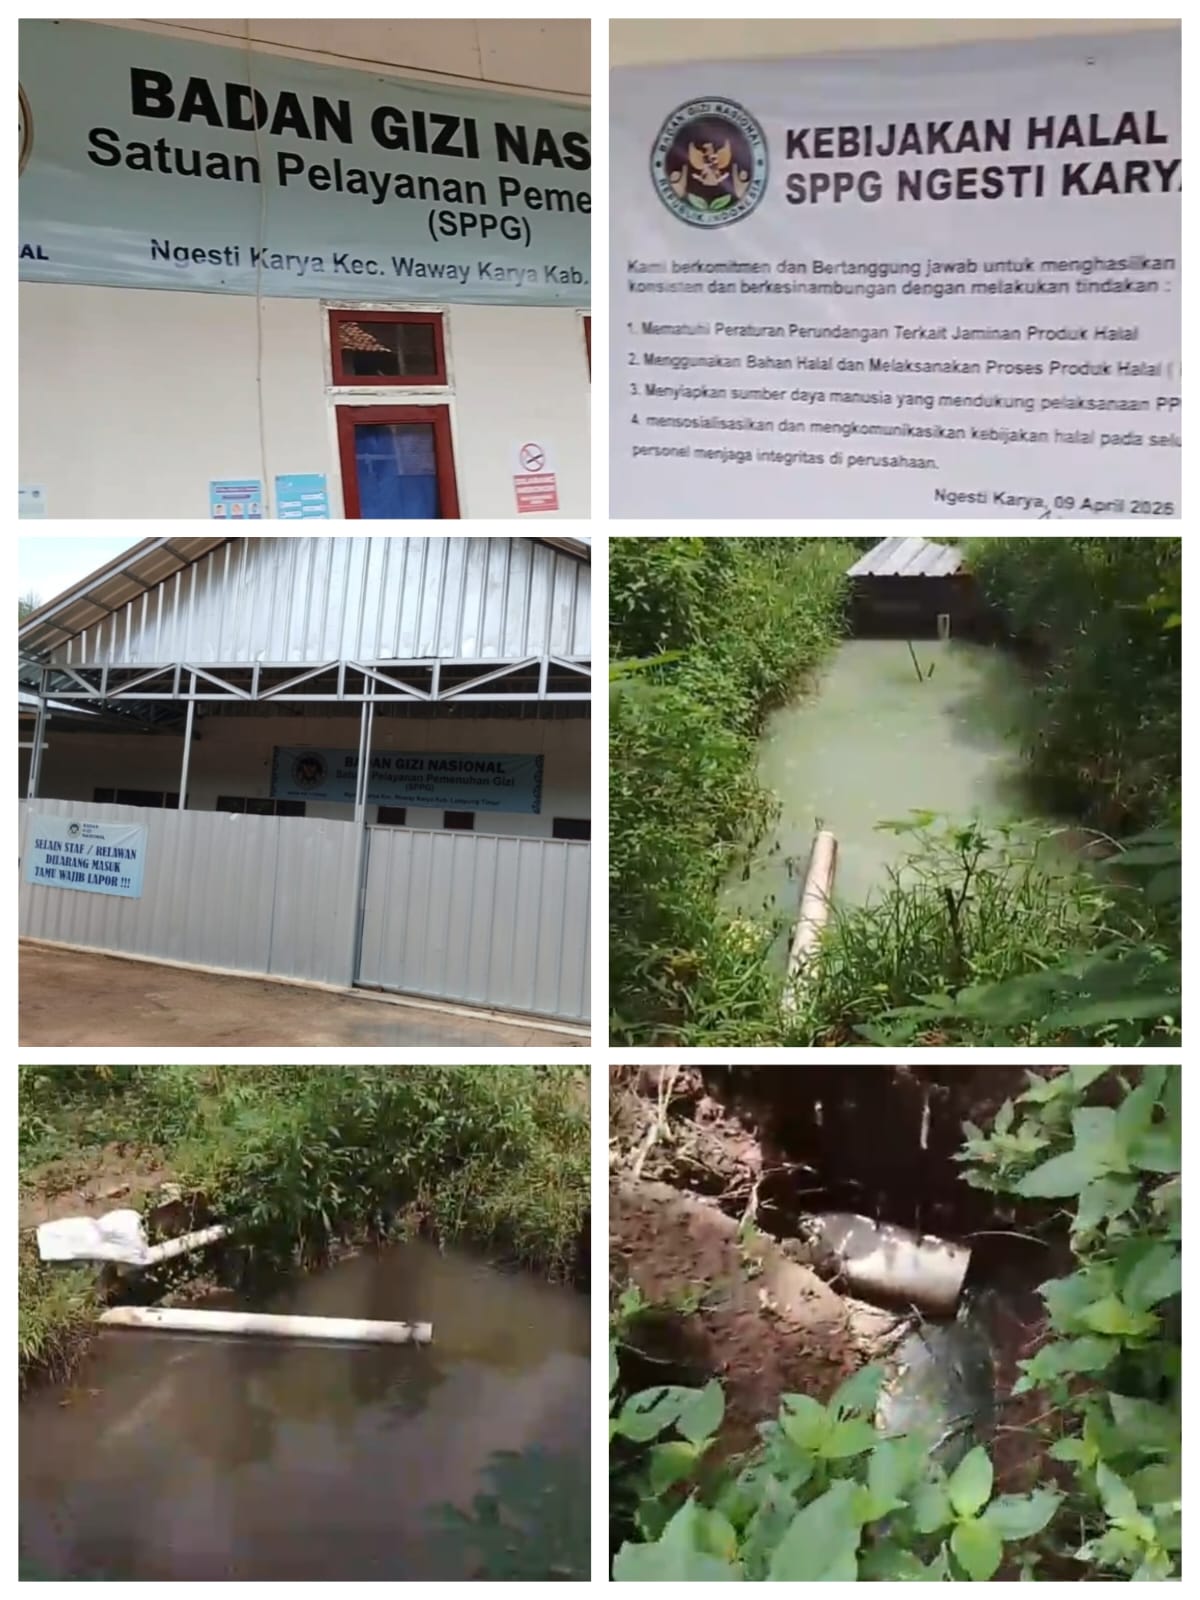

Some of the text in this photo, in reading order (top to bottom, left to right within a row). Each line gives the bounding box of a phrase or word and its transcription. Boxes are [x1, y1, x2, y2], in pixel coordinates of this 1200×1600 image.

[130, 67, 591, 171] BADAN GIZI NAS
[785, 110, 1169, 160] KEBIJAKAN HALAL
[87, 126, 591, 214] Satuan Pelayanan Peme
[785, 157, 1181, 205] SPPG NGESTI KARY
[428, 208, 532, 248] (SPPG)
[150, 238, 590, 287] Ngesti Karya Kec. Waway Karya Kab.
[671, 259, 771, 275] berkomitmen
[776, 259, 807, 275] dan
[811, 259, 921, 278] Bertanggung
[926, 258, 978, 277] jawab
[983, 257, 1035, 273] untuk
[1040, 255, 1176, 275] menghasilkan
[707, 279, 737, 294] dan
[740, 279, 897, 298] berkesinambungan
[901, 280, 966, 298] dengan
[971, 279, 1070, 294] melakukan
[1075, 277, 1159, 293] tindakan
[714, 322, 785, 337] Peraturan
[788, 323, 888, 342] Perundangan
[894, 325, 948, 340] Terkait
[951, 326, 1021, 341] Jaminan
[1027, 325, 1089, 341] Produk
[1093, 326, 1139, 341] Halal
[628, 352, 640, 366] 2.
[644, 352, 741, 370] Menggunakan
[746, 354, 792, 369] Bahan
[796, 355, 833, 371] Halal
[837, 356, 865, 372] dan
[868, 358, 981, 374] Melaksanakan
[986, 360, 1044, 375] Proses
[1049, 360, 1112, 376] Produk
[1116, 361, 1162, 377] Halal
[630, 383, 640, 396] 3.
[644, 383, 727, 400] Menyiapkan
[730, 385, 787, 401] sumber
[790, 389, 826, 405] daya
[829, 389, 893, 405] manusia
[895, 394, 935, 410] yang
[938, 394, 1035, 413] mendukung
[1040, 396, 1151, 411] pelaksanaan
[646, 416, 774, 431] mensosialisasikan
[778, 418, 806, 434] dan
[809, 422, 966, 438] mengkomunikasikan
[971, 426, 1049, 444] kebijakan
[1054, 427, 1096, 444] halal
[1100, 433, 1143, 448] pada
[632, 445, 940, 470] personel menjaga integritas di perusahaan.
[934, 489, 988, 505] Ngesti
[993, 491, 1049, 510] Karya,
[1054, 496, 1075, 509] 09
[1079, 497, 1125, 513] April
[395, 758, 424, 771] GIZI
[428, 759, 505, 775] NASIONAL
[35, 839, 62, 851] SELAIN
[64, 842, 85, 855] STAF
[96, 845, 137, 860] RELAWAN
[45, 854, 121, 873] DILARANG MASUK
[35, 866, 131, 889] TAMU WAJIB LAPOR !!!
